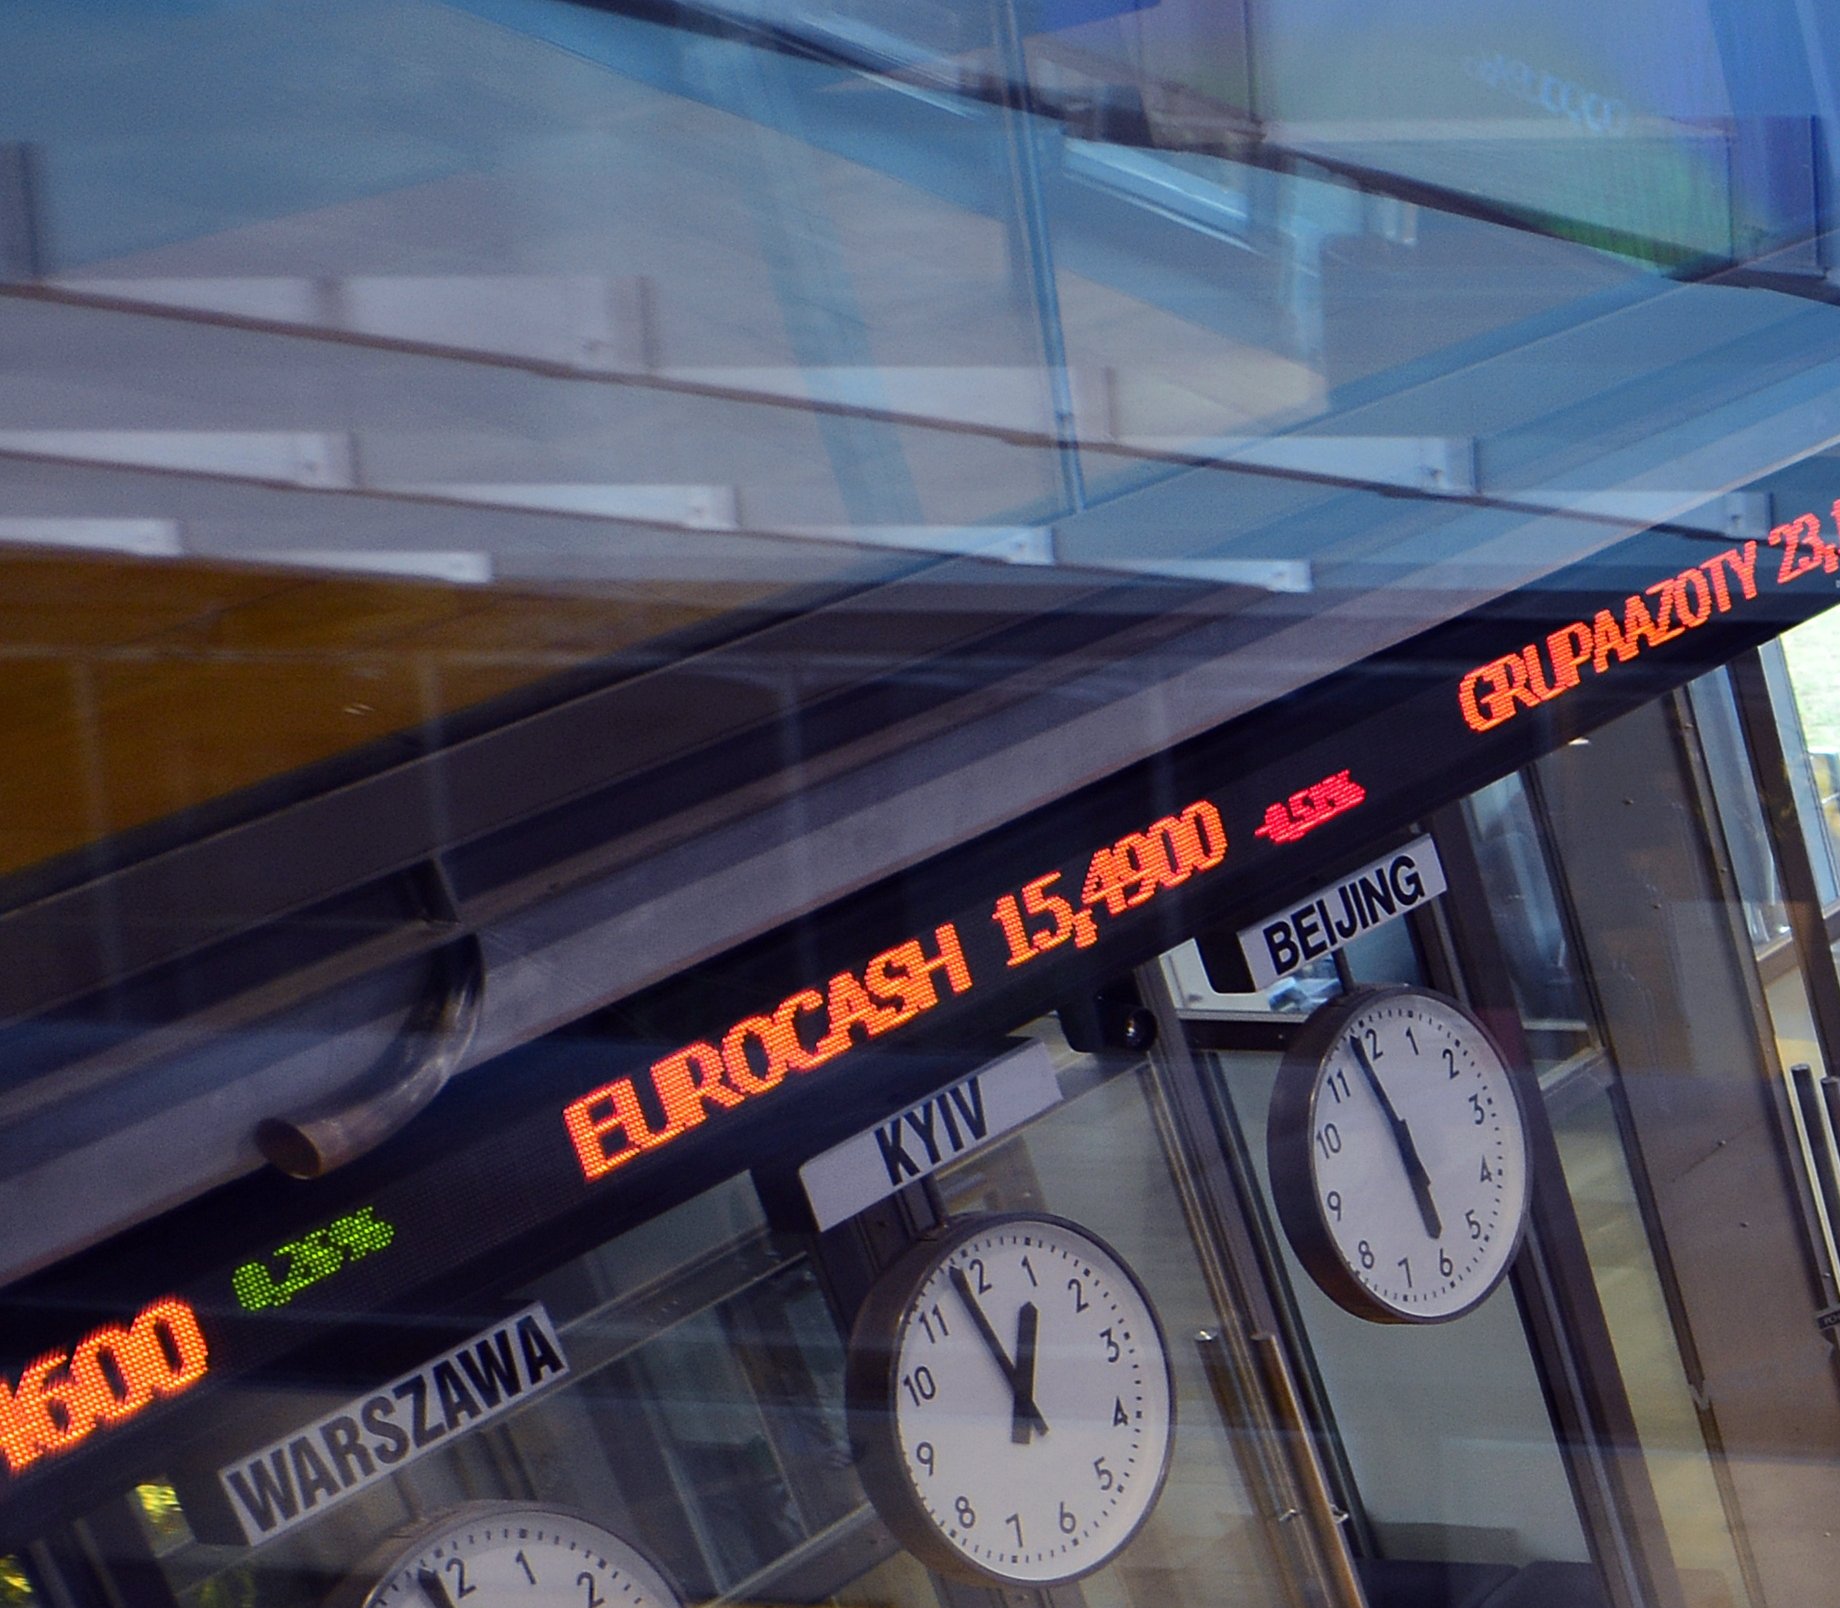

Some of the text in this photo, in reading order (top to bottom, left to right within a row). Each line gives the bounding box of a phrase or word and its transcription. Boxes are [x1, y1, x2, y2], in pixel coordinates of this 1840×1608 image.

[1459, 542, 1759, 732] GRUPAAZOTY
[1262, 853, 1426, 976] BEIJING
[562, 923, 973, 1181] EUROCASH
[992, 799, 1229, 967] 15,4900
[876, 1076, 988, 1186] KYIV
[232, 1205, 395, 1312] 0,26%
[1021, 1256, 1038, 1286] 1
[1068, 1279, 1089, 1313] 2
[919, 1304, 950, 1343] 11
[1100, 1329, 1120, 1362] 3
[903, 1365, 936, 1407] 10
[227, 1315, 561, 1532] WARSZAWA
[916, 1442, 934, 1476] 9
[1093, 1458, 1113, 1490] 5
[955, 1497, 975, 1529] 8
[1058, 1502, 1076, 1534] 6
[516, 1550, 538, 1584] 1
